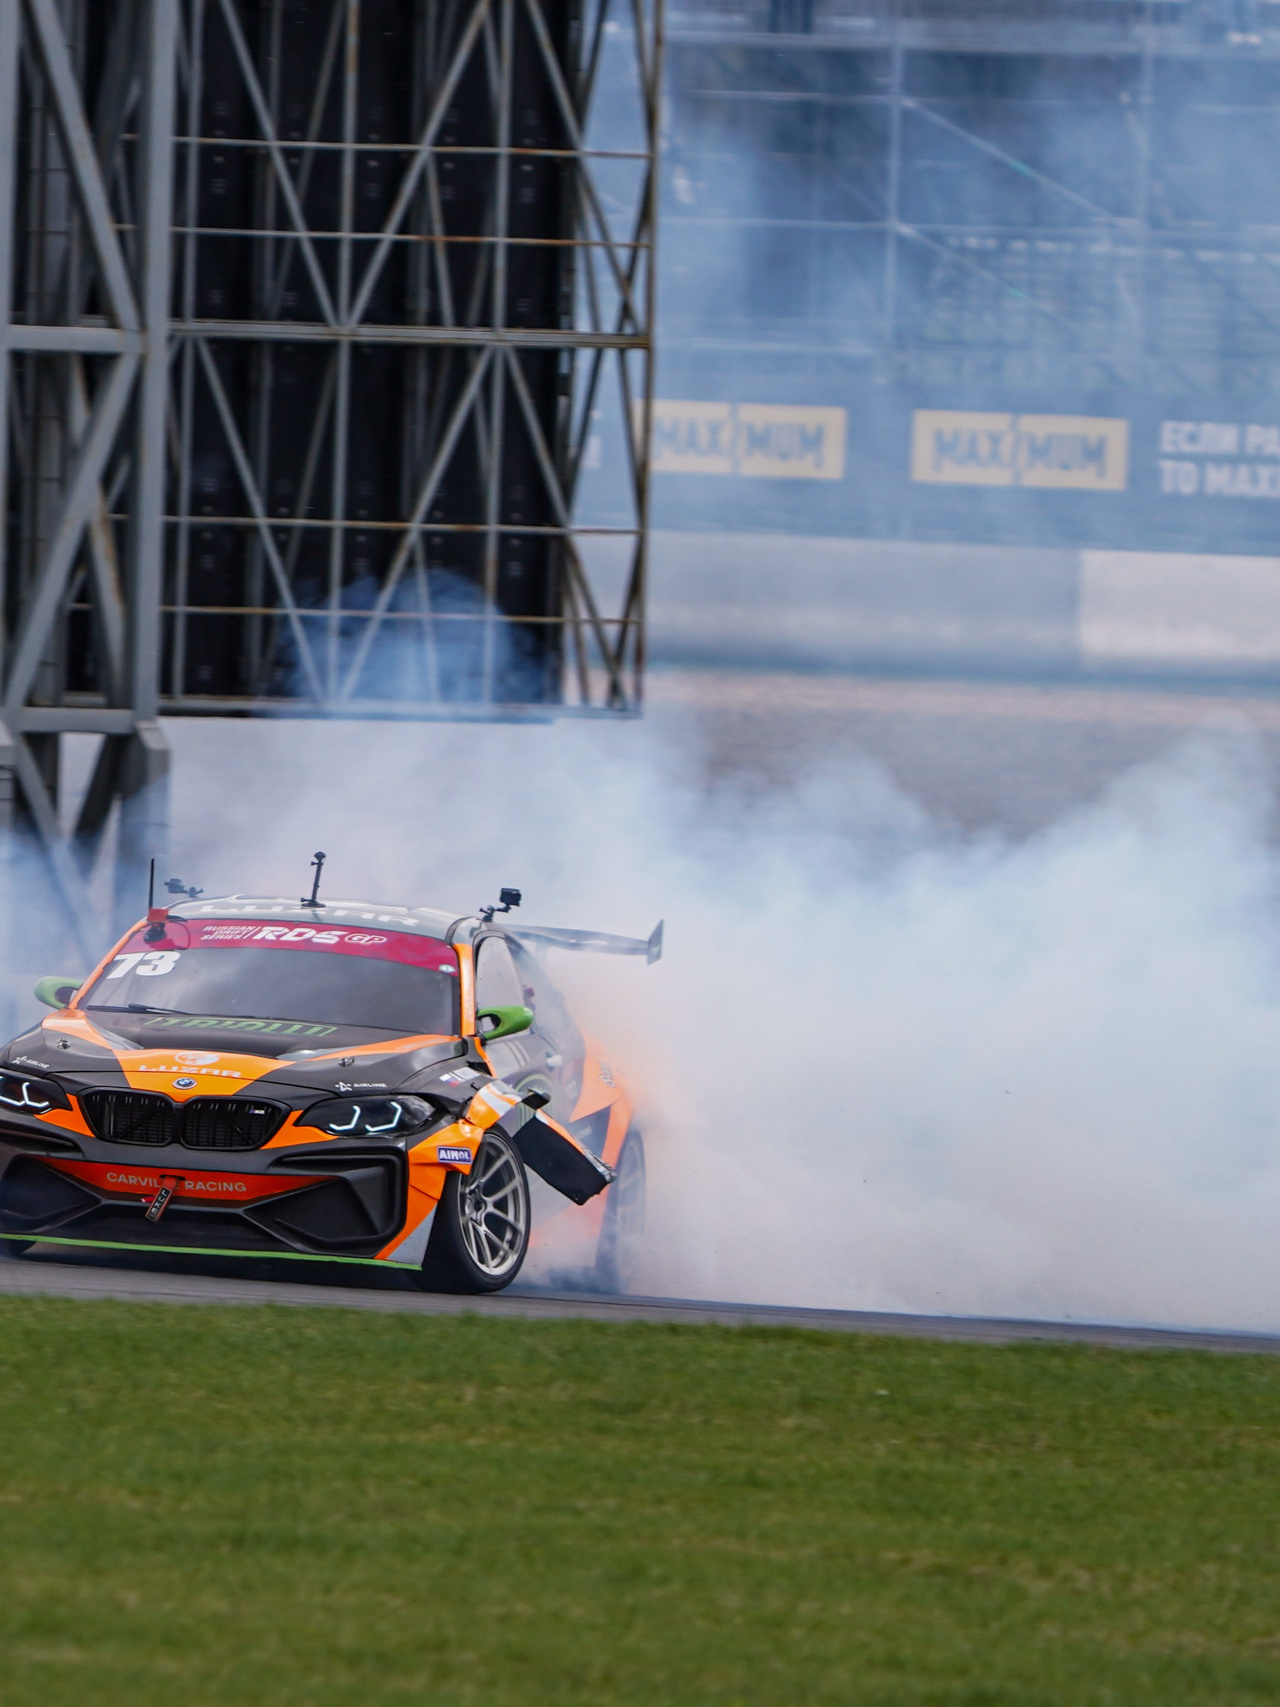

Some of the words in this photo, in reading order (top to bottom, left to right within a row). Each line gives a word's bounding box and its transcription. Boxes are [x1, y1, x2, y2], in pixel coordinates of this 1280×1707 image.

[252, 926, 349, 944] RDS
[344, 933, 387, 945] GP
[106, 951, 181, 980] 73
[139, 1064, 243, 1078] LUZAR
[106, 1172, 181, 1190] CARVIL
[184, 1180, 247, 1192] RACING
